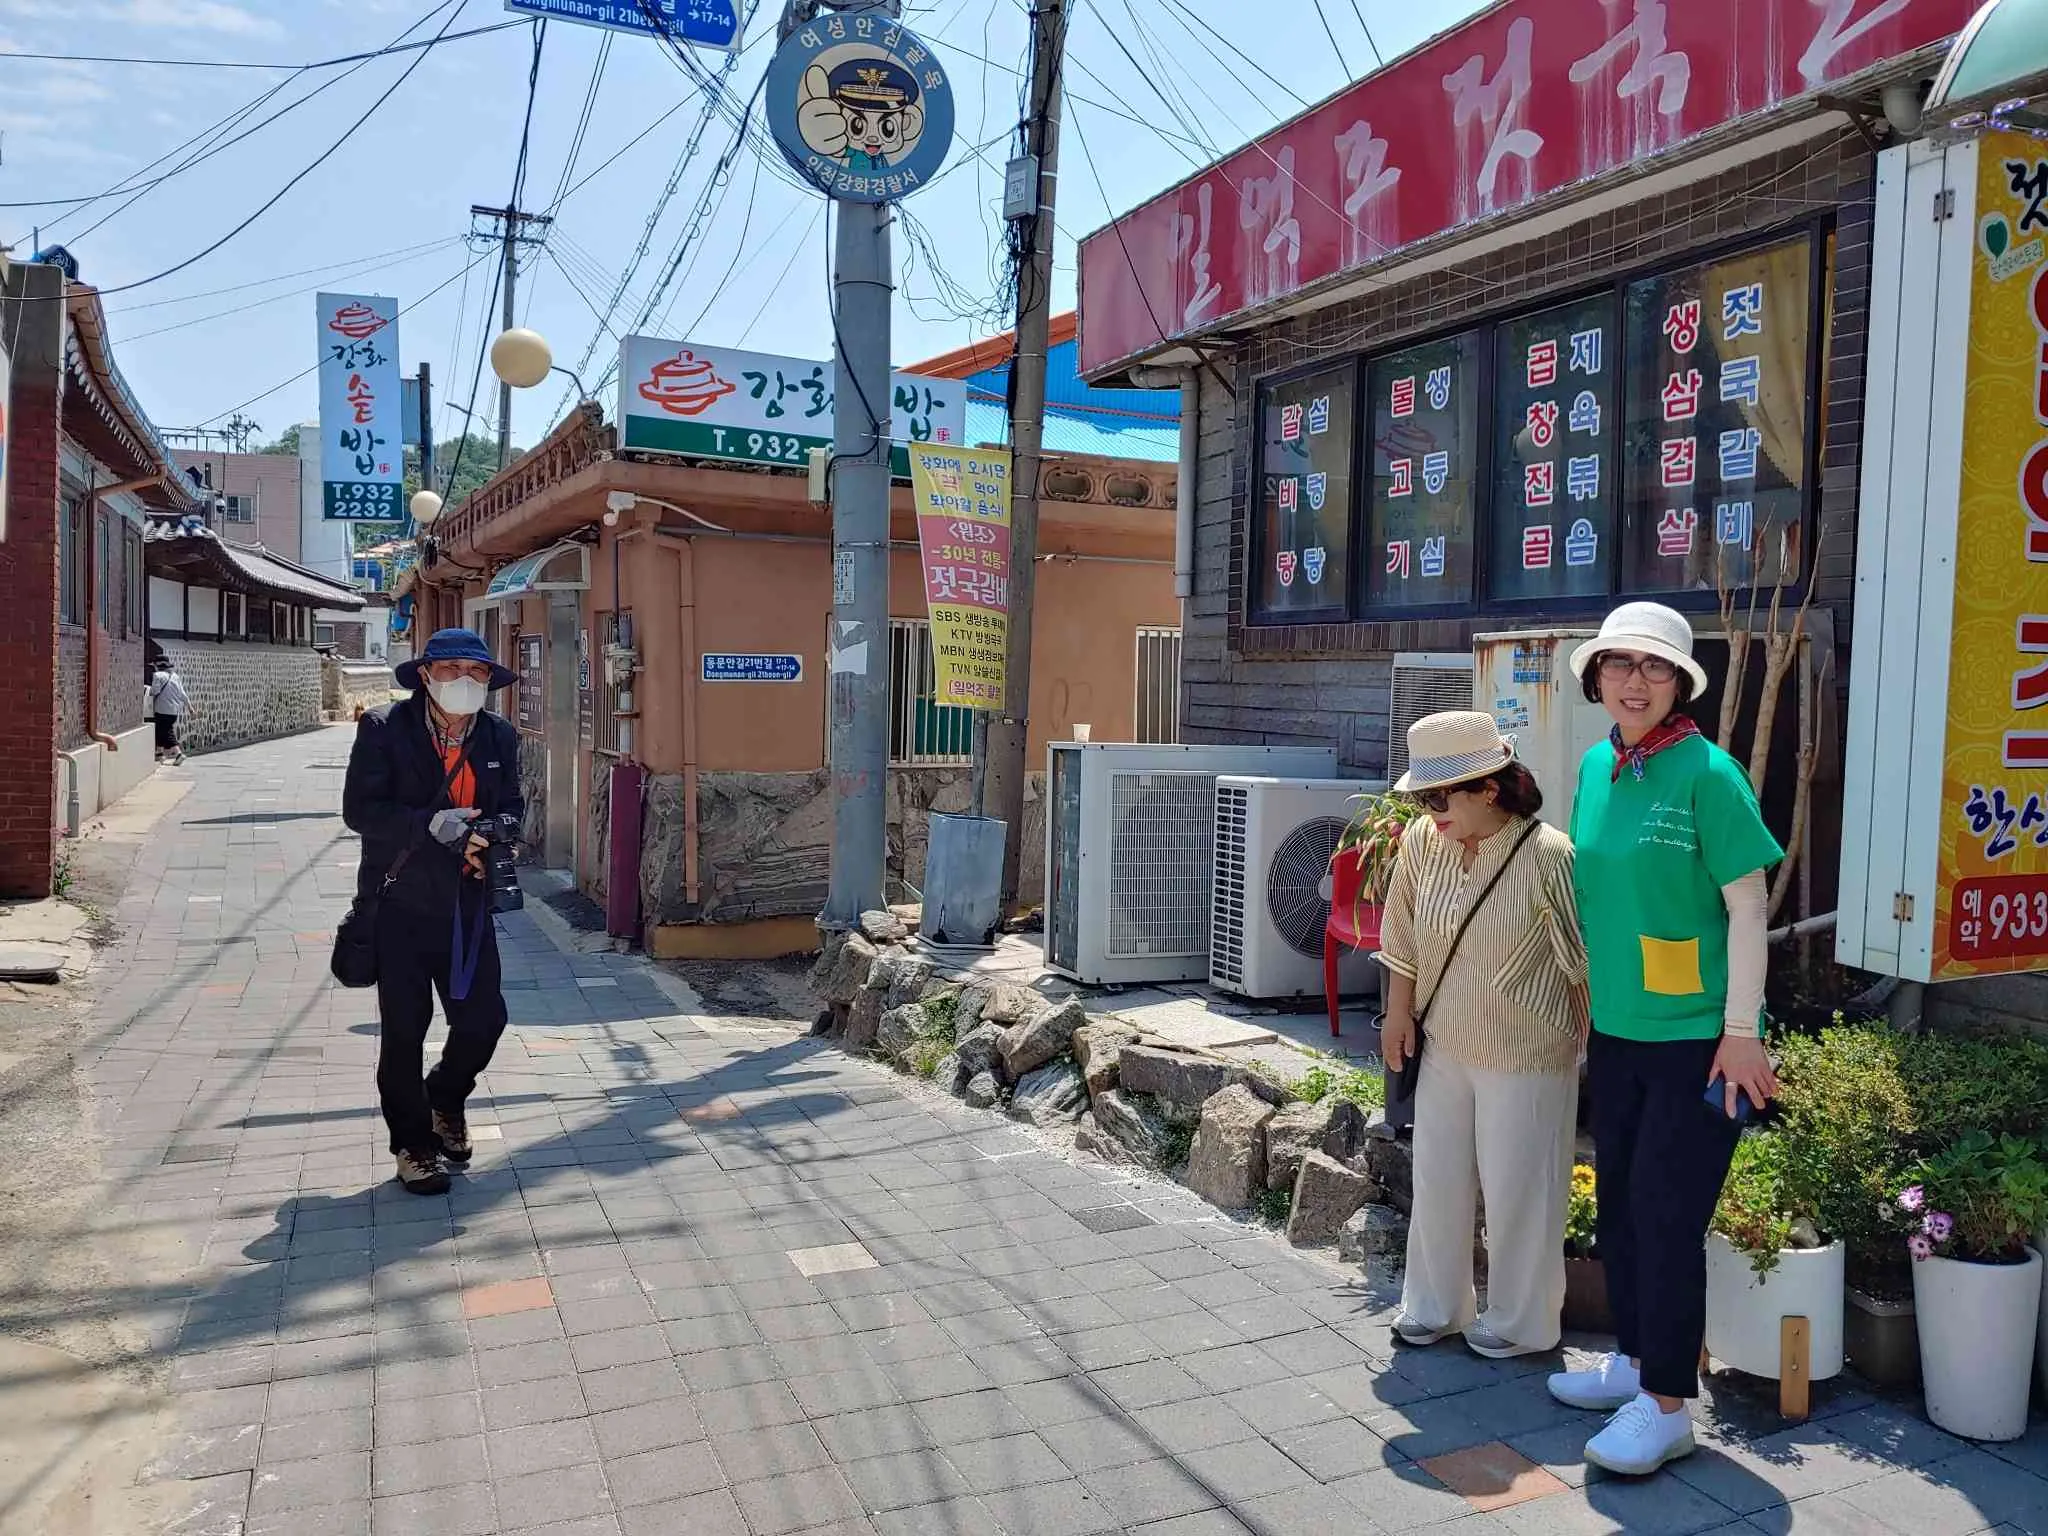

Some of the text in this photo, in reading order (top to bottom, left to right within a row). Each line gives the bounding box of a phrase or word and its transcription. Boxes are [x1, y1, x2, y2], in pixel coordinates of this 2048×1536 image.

[513, 0, 615, 21] ongmunan-gil
[701, 11, 731, 27] 17-14
[331, 341, 388, 369] 강화
[741, 366, 834, 418] 강화
[1658, 300, 1702, 557] 생삼겹살
[1717, 283, 1763, 551] 젓국갈비
[1523, 340, 1559, 569] 곱창전골
[1566, 328, 1602, 566] 제육볶음
[919, 454, 1006, 480] 강화에 오시면
[1420, 366, 1450, 577] 생등심
[332, 483, 394, 501] T.932
[975, 481, 999, 498] 먹어
[1276, 403, 1303, 587] 갈비탕
[1303, 396, 1330, 584] 설렁탕
[334, 501, 391, 518] 2232
[930, 566, 1008, 608] 젓국갈비
[935, 610, 961, 623] SBS
[951, 628, 973, 641] KTV
[940, 645, 965, 657] MBN
[950, 662, 971, 675] TVN
[1989, 891, 2048, 940] 933
